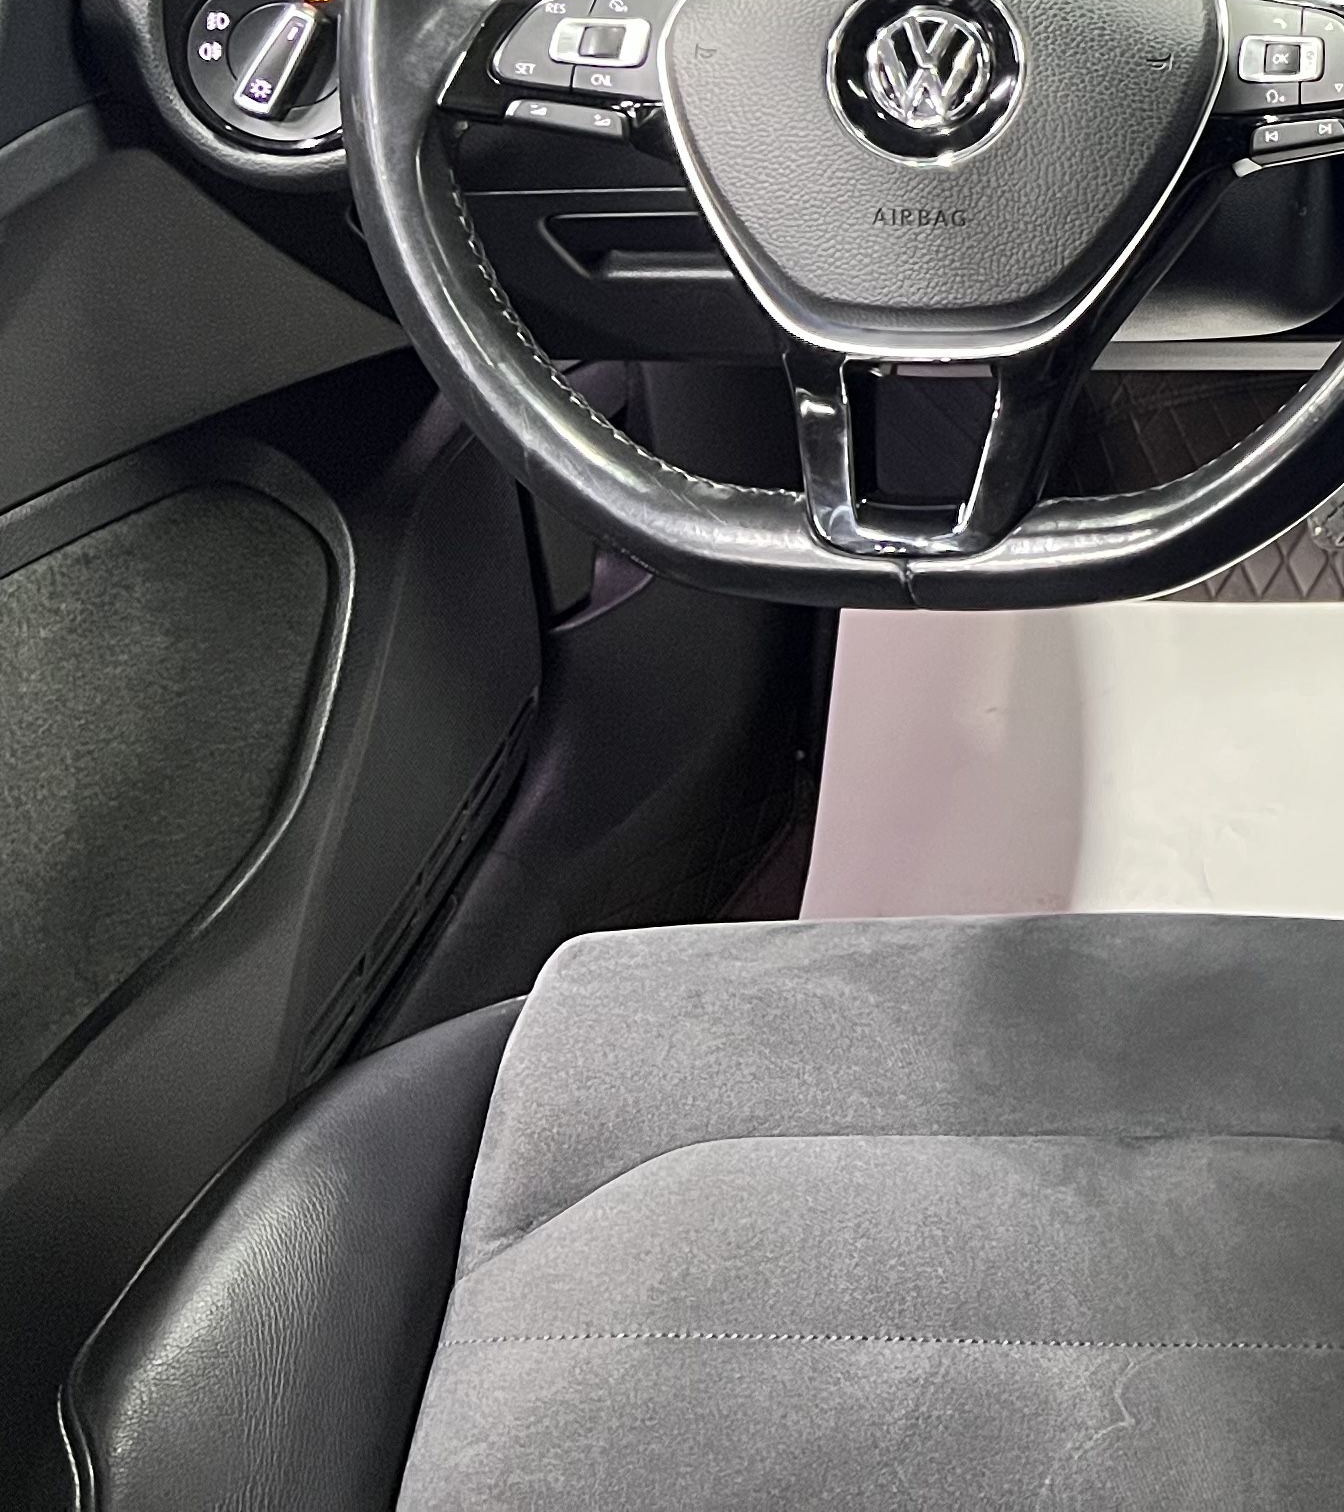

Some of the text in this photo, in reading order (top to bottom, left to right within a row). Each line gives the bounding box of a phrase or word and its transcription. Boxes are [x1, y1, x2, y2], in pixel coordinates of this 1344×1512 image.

[545, 2, 566, 15] RES
[1272, 52, 1290, 65] OK
[515, 62, 536, 75] SET
[591, 73, 612, 87] CNL
[872, 206, 967, 228] AIRBAG
